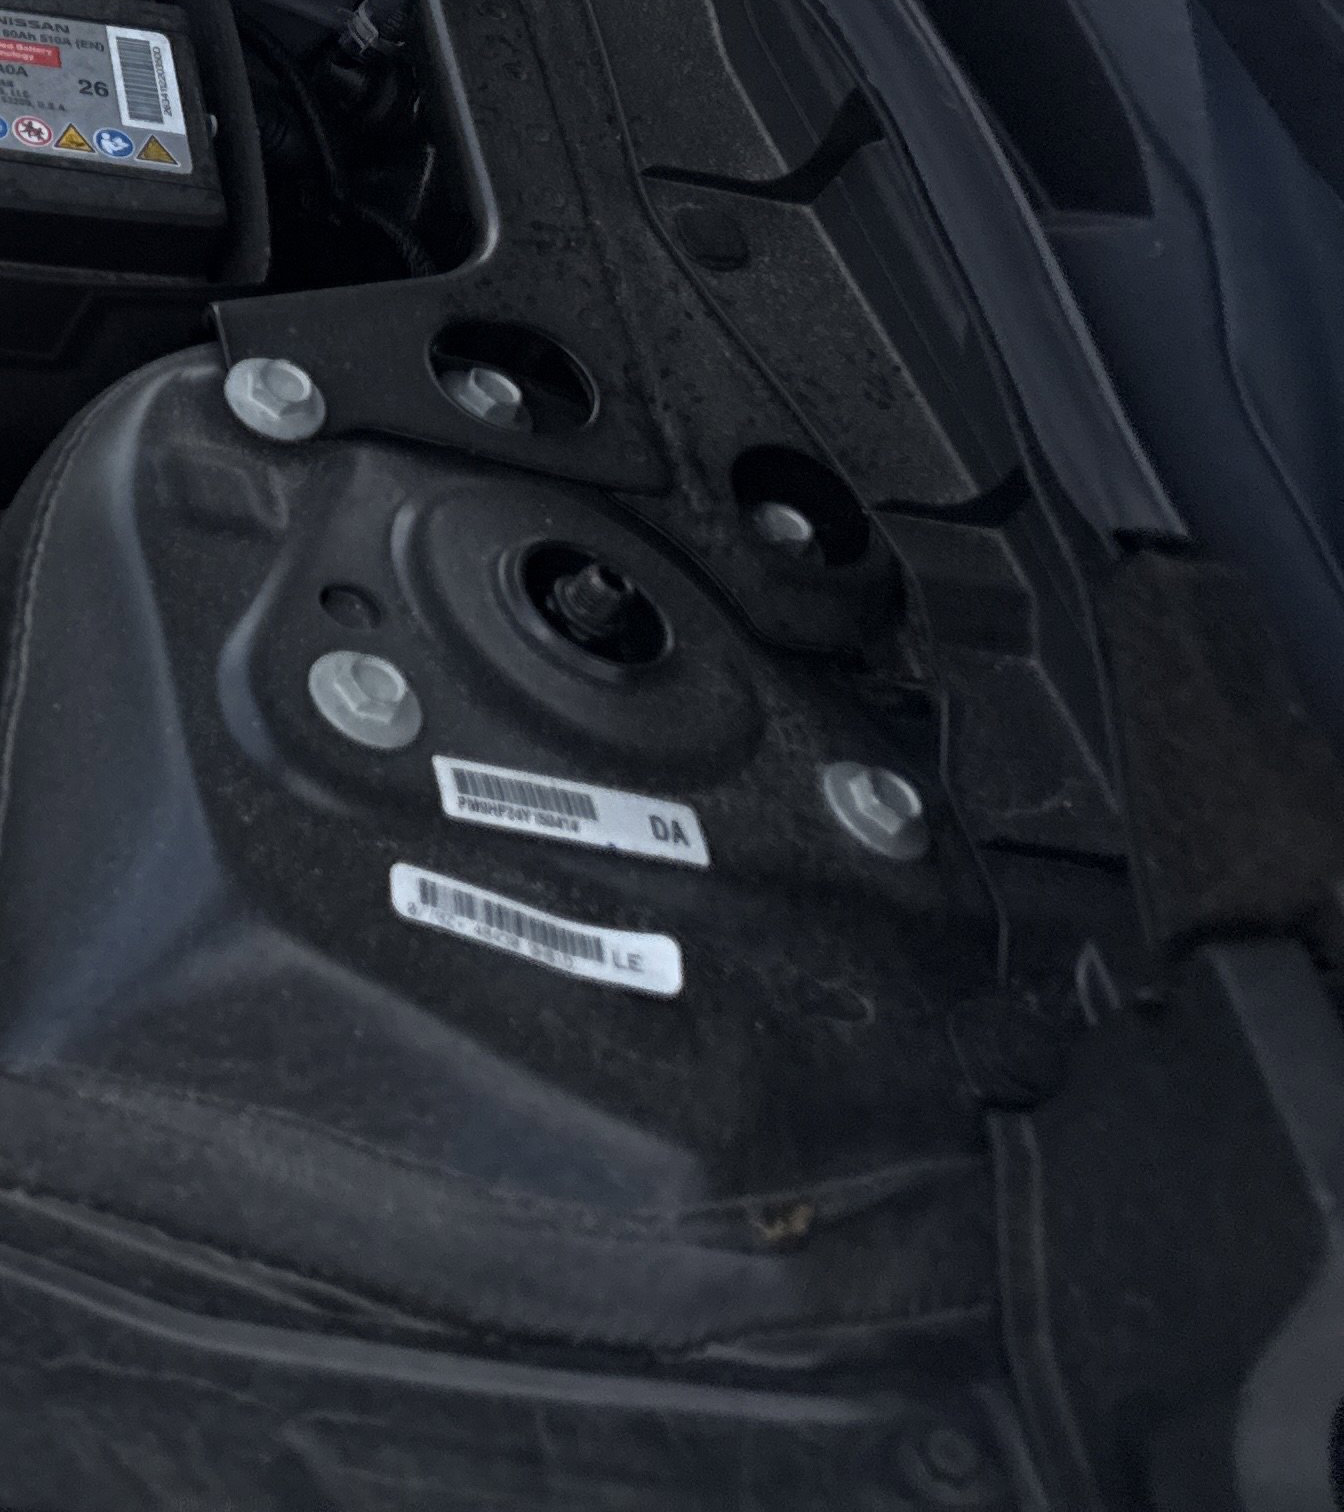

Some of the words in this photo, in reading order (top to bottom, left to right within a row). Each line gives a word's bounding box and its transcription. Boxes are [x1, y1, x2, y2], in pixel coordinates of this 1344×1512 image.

[17, 43, 52, 58] Battery
[76, 38, 105, 52] (EN)
[78, 79, 109, 98] 26
[649, 814, 690, 847] DA
[611, 949, 643, 972] LE
